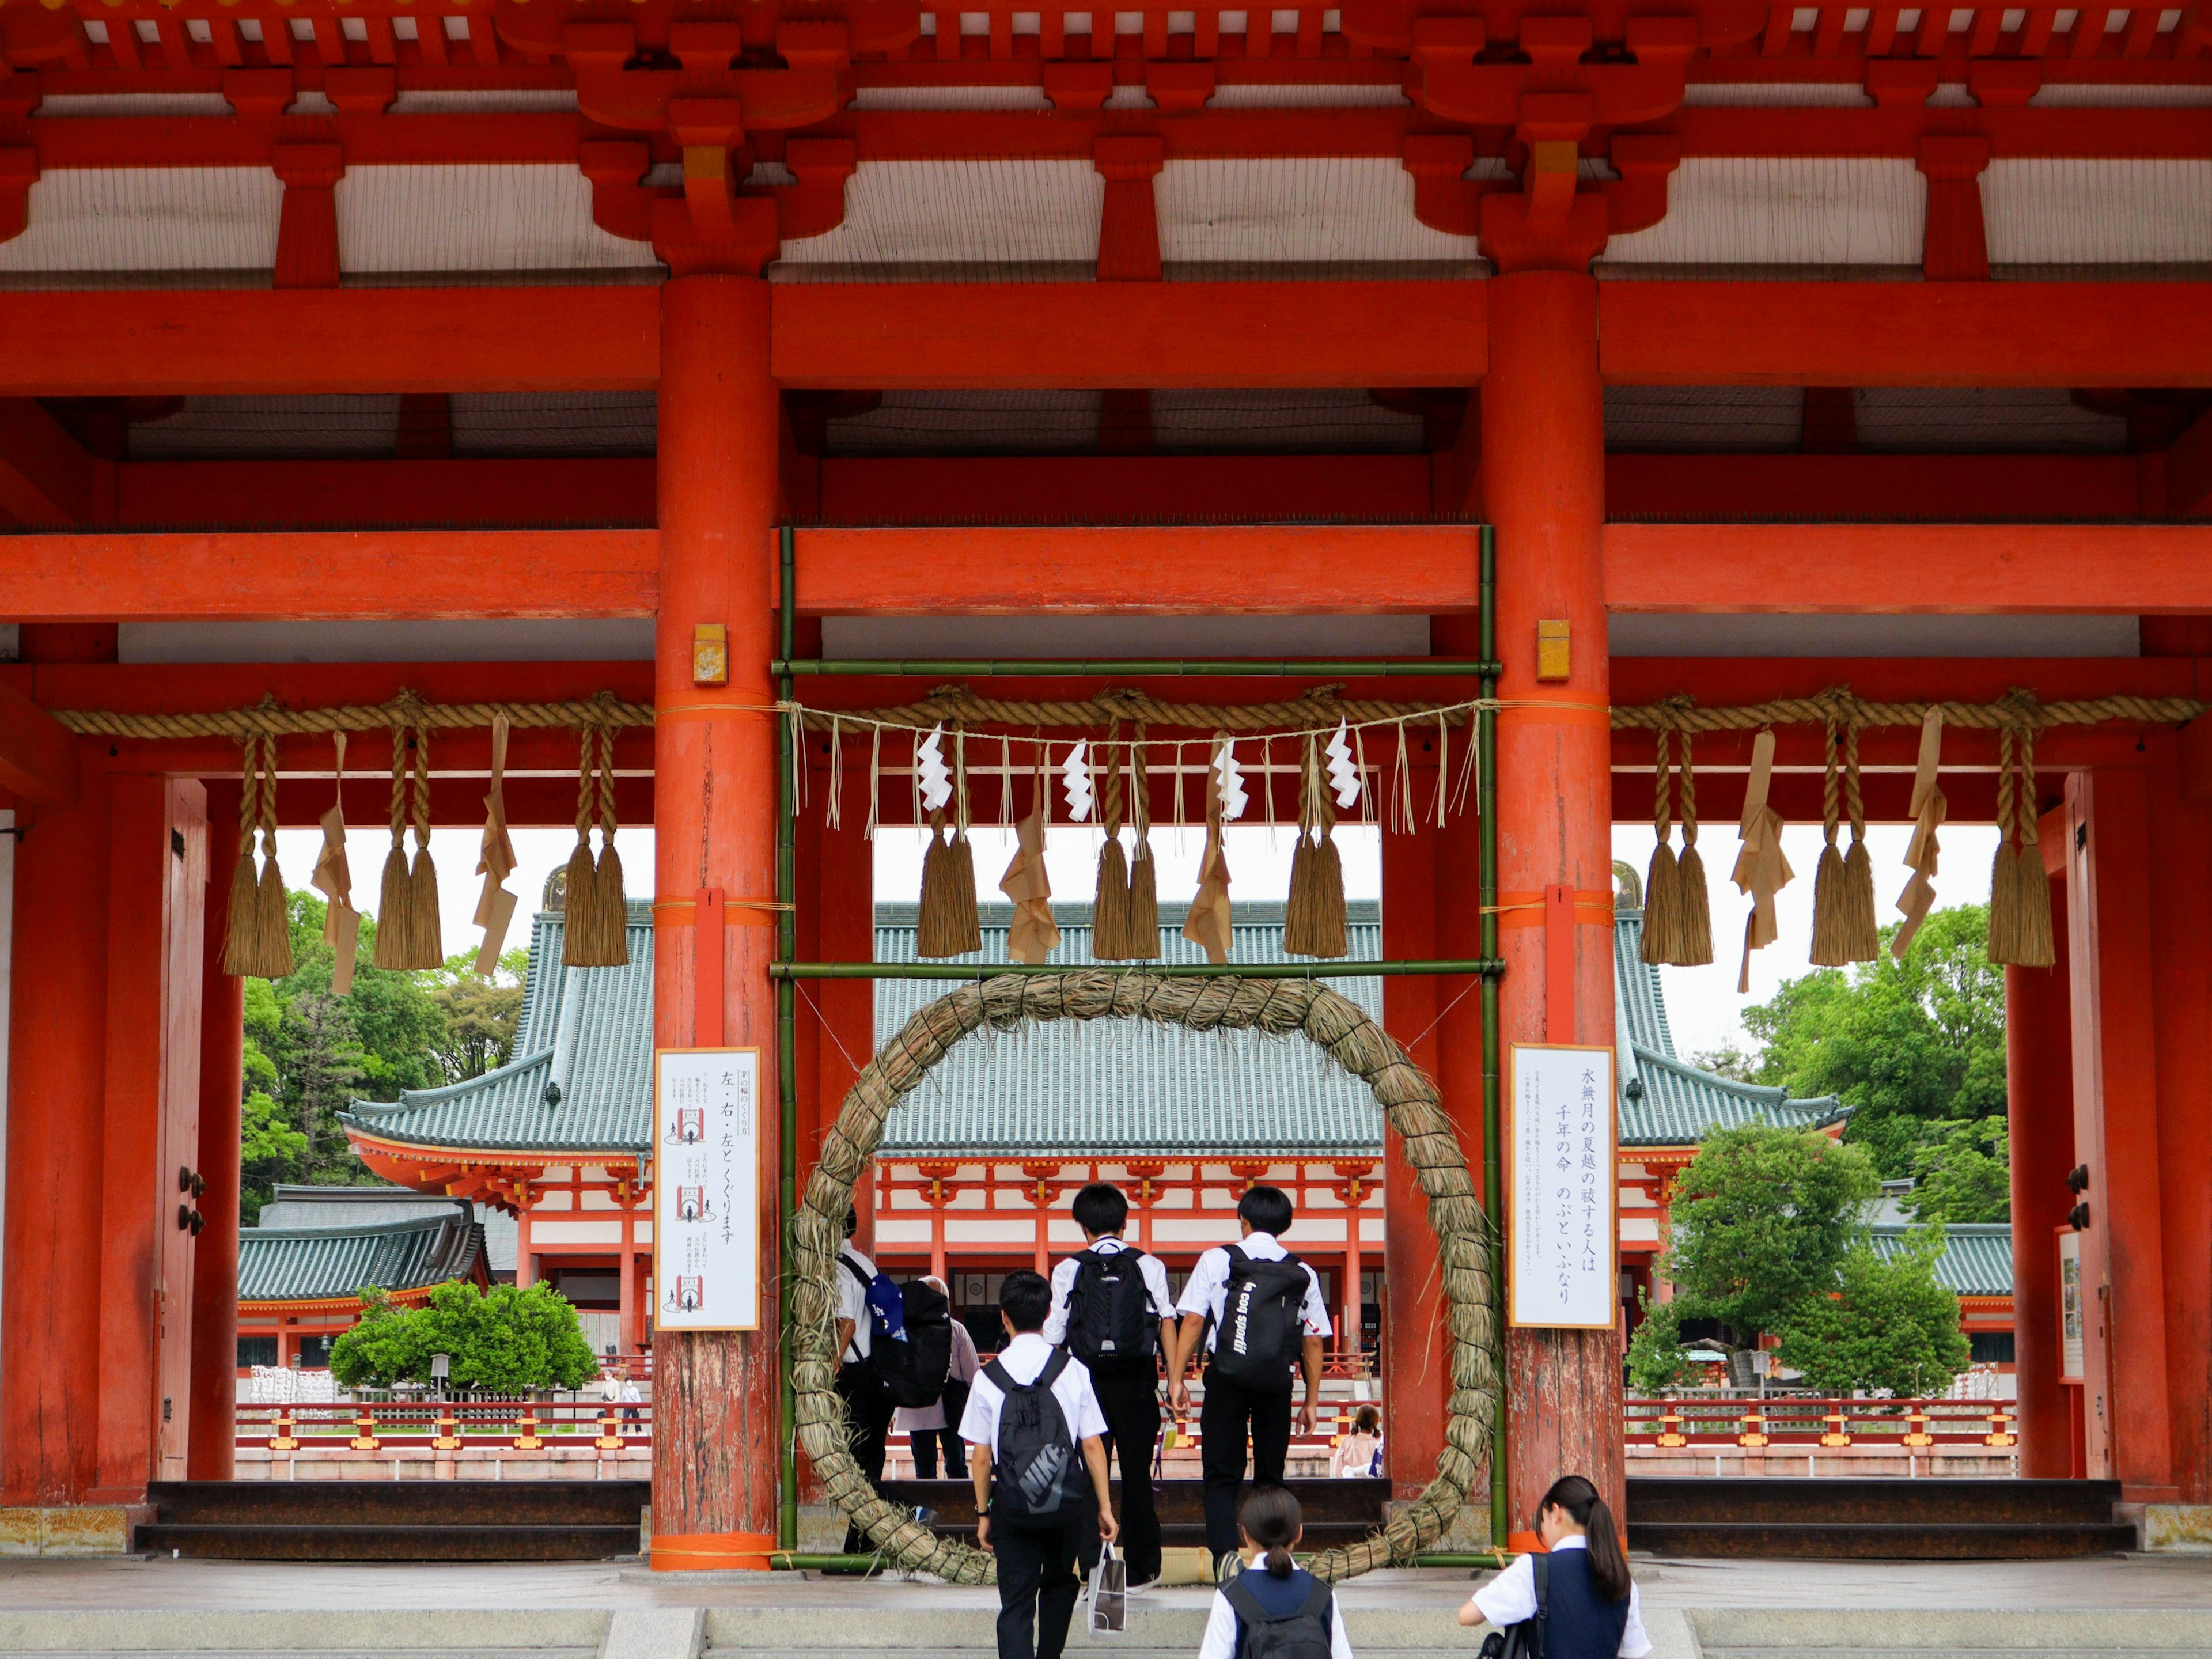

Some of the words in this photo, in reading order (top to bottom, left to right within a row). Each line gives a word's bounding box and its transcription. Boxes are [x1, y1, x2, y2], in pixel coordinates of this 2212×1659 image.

[1556, 1105, 1572, 1172] 千年の命
[1581, 1069, 1596, 1271] 水無月の夏越の祓する人は
[1556, 1188, 1572, 1304] のぶといふなり
[872, 1304, 885, 1316] LA
[1236, 1292, 1250, 1315] coq
[1243, 1282, 1257, 1292] le
[1233, 1314, 1248, 1355] sportif
[1018, 1444, 1068, 1503] NIKE
